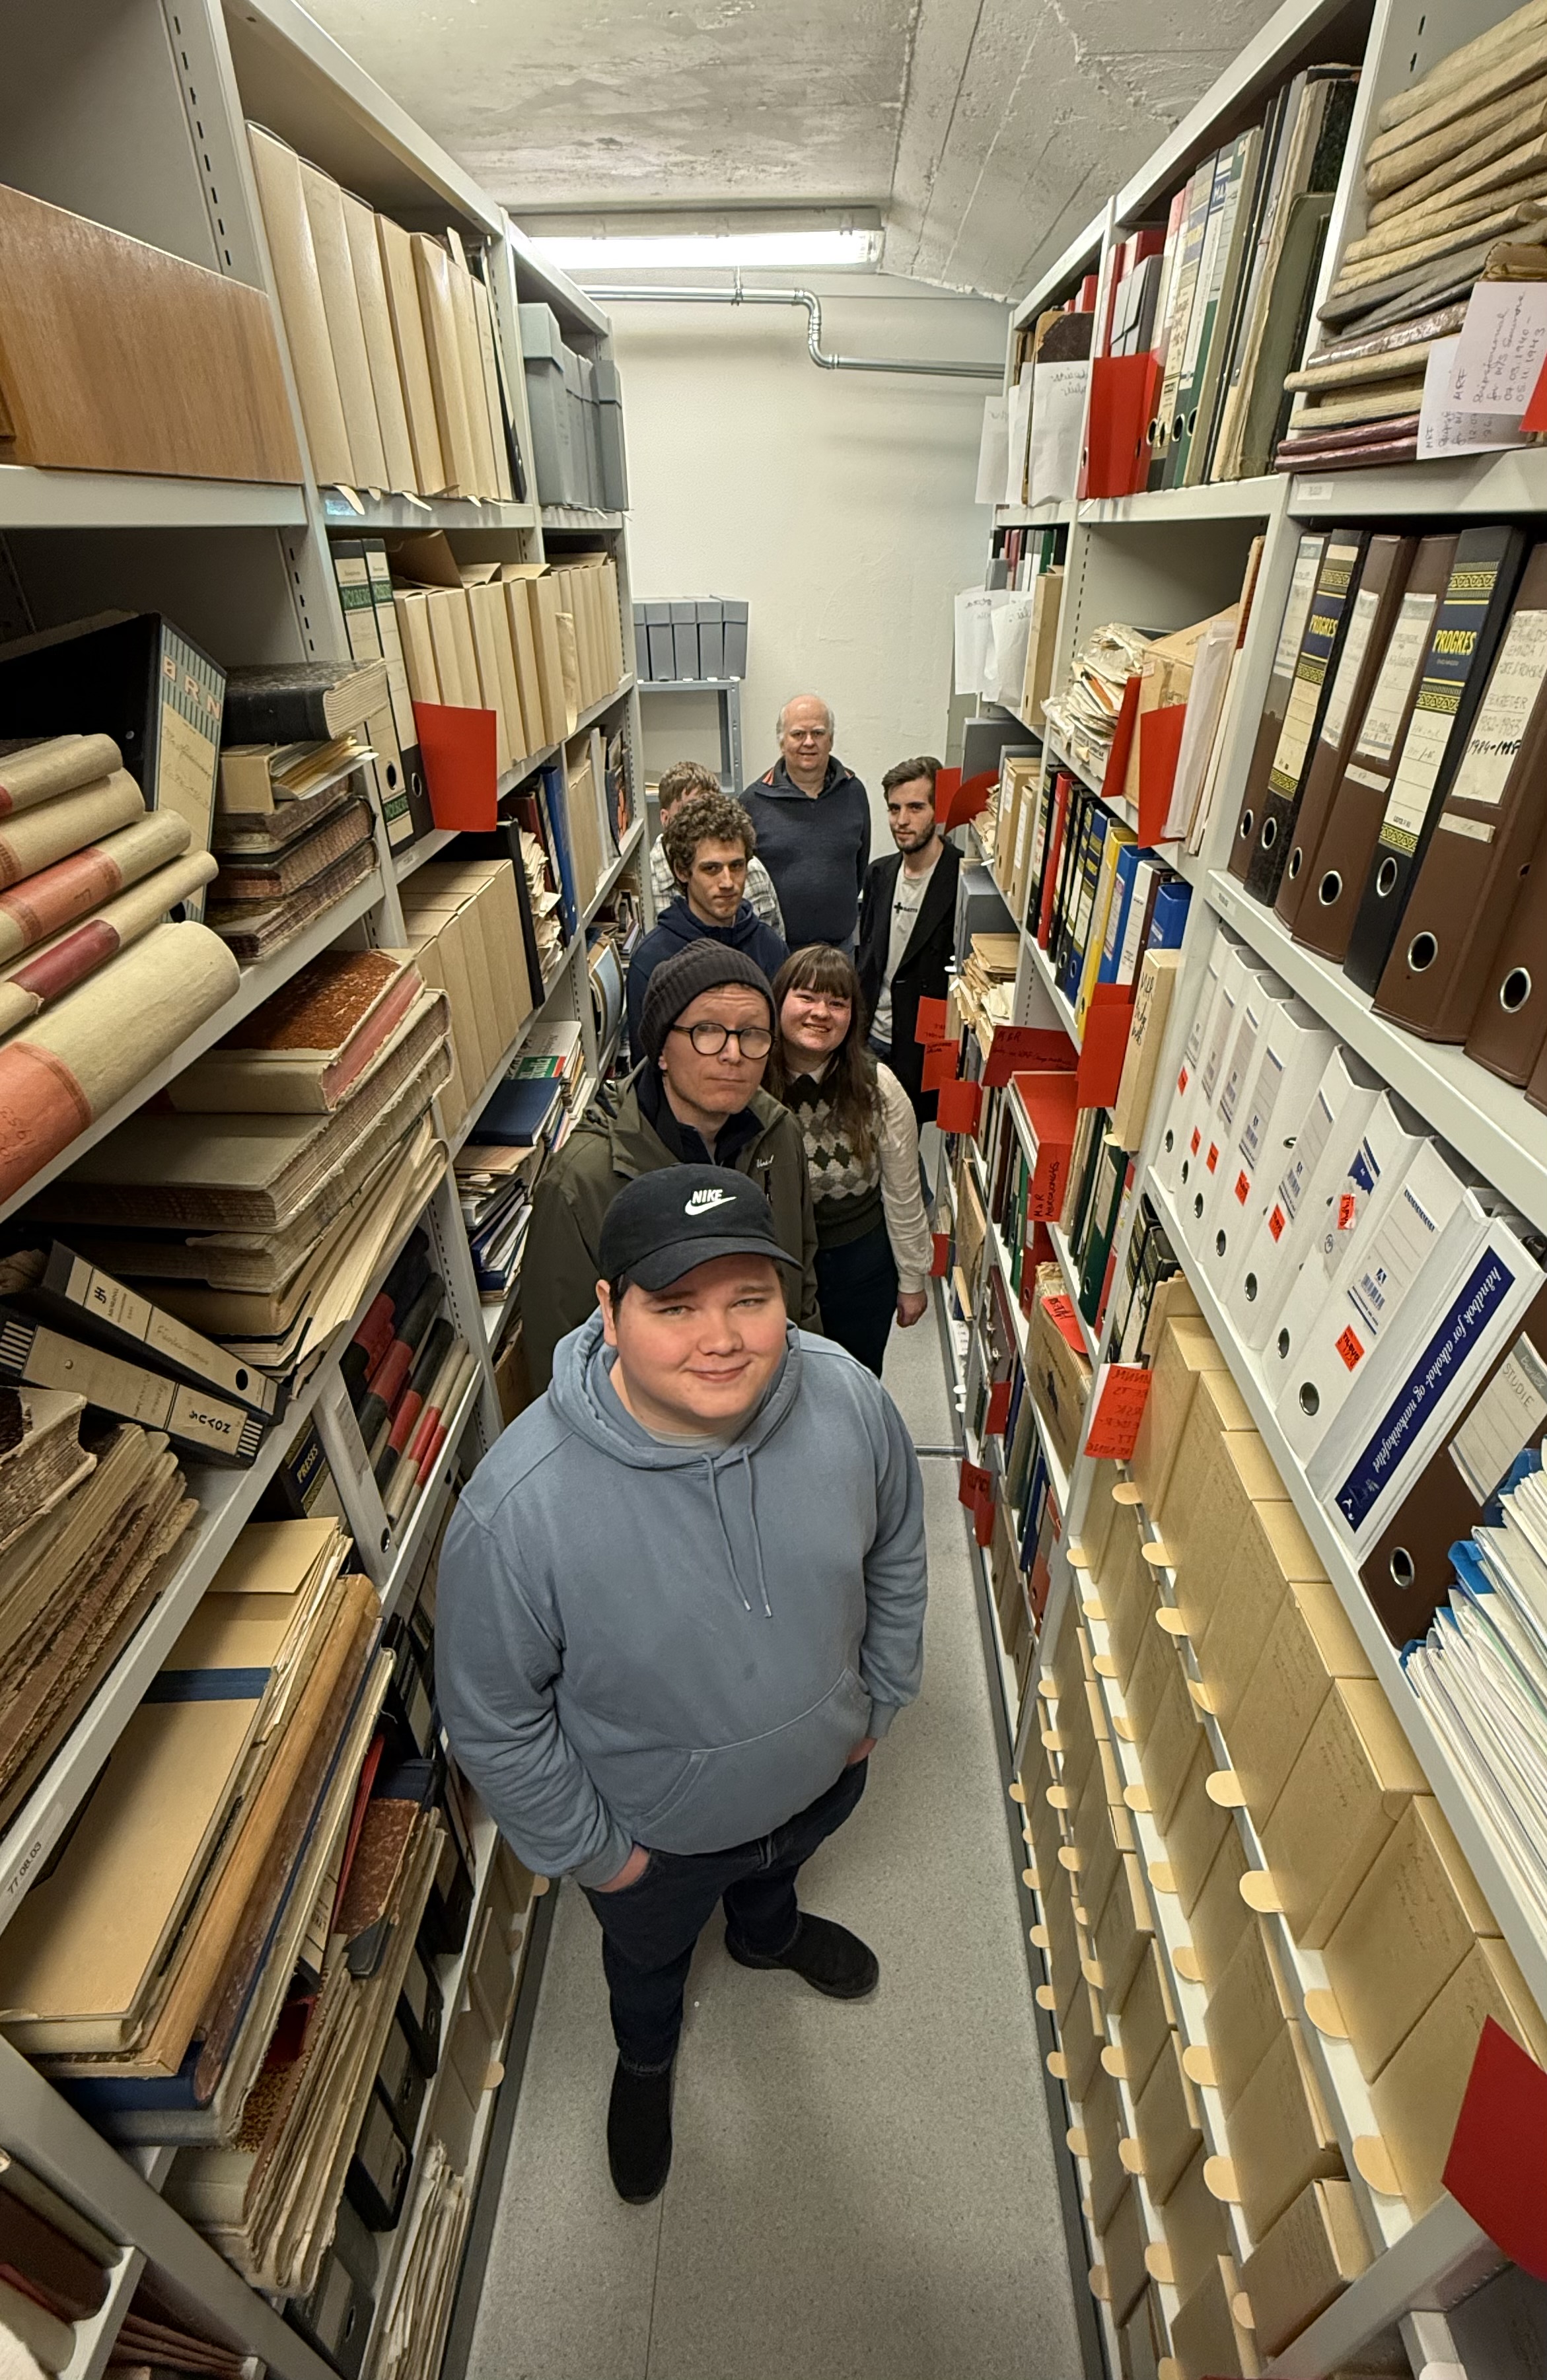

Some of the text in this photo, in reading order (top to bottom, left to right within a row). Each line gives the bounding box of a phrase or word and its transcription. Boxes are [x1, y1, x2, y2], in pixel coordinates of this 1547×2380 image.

[1309, 614, 1339, 638] PROGRES
[1432, 629, 1478, 656] PROGRES
[163, 655, 221, 721] BRN
[692, 1189, 723, 1204] NIKE
[1464, 1266, 1502, 1325] håndbok
[1453, 1315, 1468, 1345] for
[1425, 1339, 1453, 1388] alkohol-
[1413, 1384, 1425, 1401] og
[1501, 1362, 1535, 1409] STUDIE
[189, 1411, 231, 1434] NOVUS
